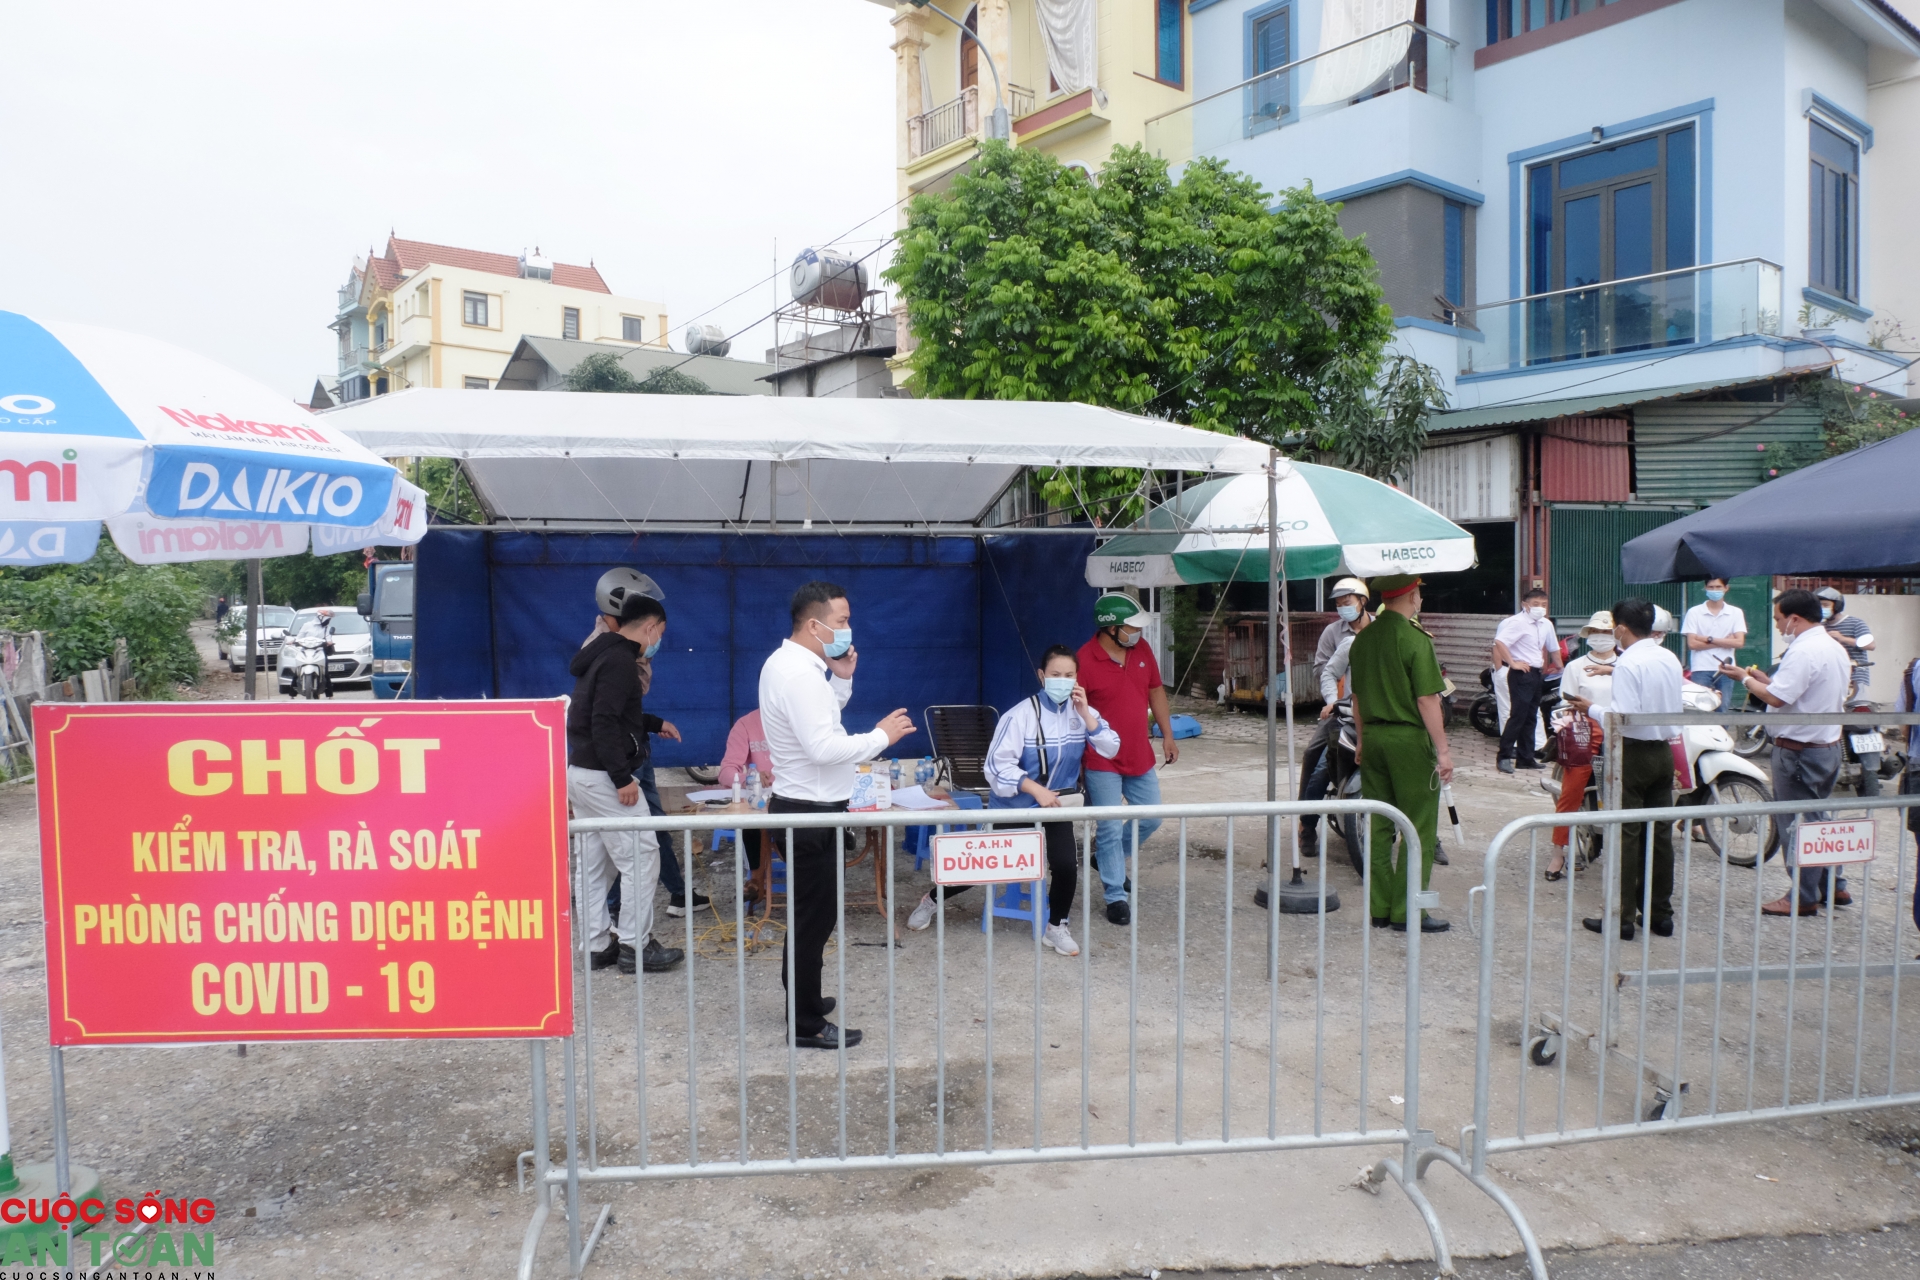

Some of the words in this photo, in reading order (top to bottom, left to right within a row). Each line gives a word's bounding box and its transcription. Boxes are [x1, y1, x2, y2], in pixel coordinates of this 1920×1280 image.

[158, 405, 330, 443] Nakami
[178, 462, 363, 517] DAIKIO
[1381, 547, 1436, 561] HABECO
[1109, 561, 1146, 573] HABECO
[1097, 612, 1117, 622] Grab
[167, 718, 441, 796] CHỐT
[1820, 825, 1855, 836] C.A.H.N
[132, 814, 227, 873] KIỂM
[237, 831, 317, 876] TRA,
[329, 821, 378, 871] RÀ
[389, 821, 481, 870] SOÁT
[965, 839, 1013, 850] C.A.H.N
[1803, 837, 1845, 855] DỪNG
[1847, 838, 1870, 854] LẠI
[943, 851, 999, 871] DỪNG
[1003, 853, 1035, 871] LẠI
[75, 894, 202, 945] PHÒNG
[214, 887, 338, 943] CHỐNG
[352, 901, 435, 951] DỊCH
[447, 891, 543, 950] BỆNH
[191, 961, 329, 1016] COVID
[346, 985, 363, 997] -
[379, 961, 436, 1014] 19
